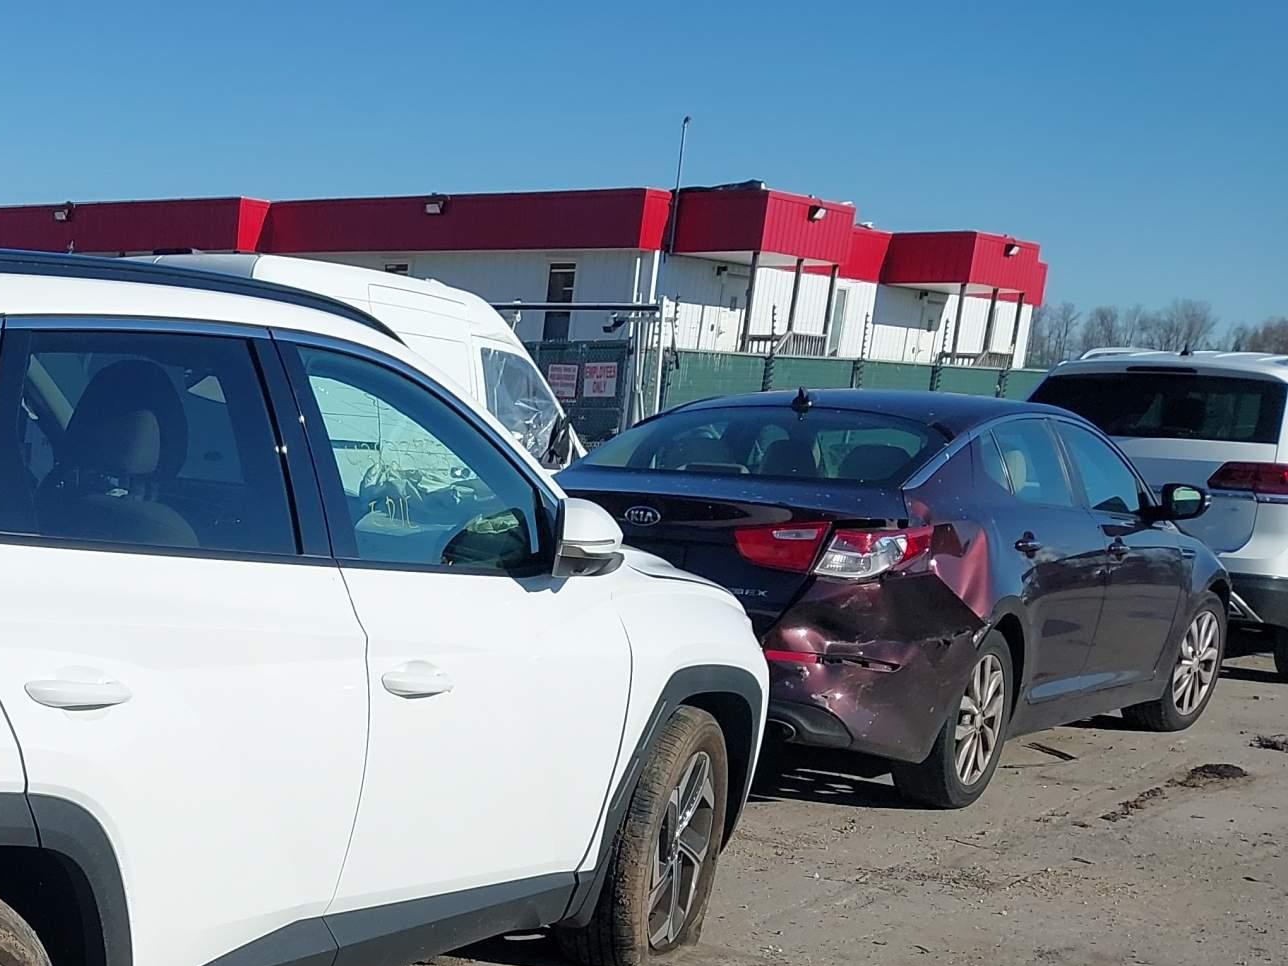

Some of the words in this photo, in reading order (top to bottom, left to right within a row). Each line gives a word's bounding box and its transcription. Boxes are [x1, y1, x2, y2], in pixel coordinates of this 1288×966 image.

[585, 365, 616, 379] EMPLOYEES
[592, 381, 608, 393] ONLY
[630, 510, 655, 522] KIA
